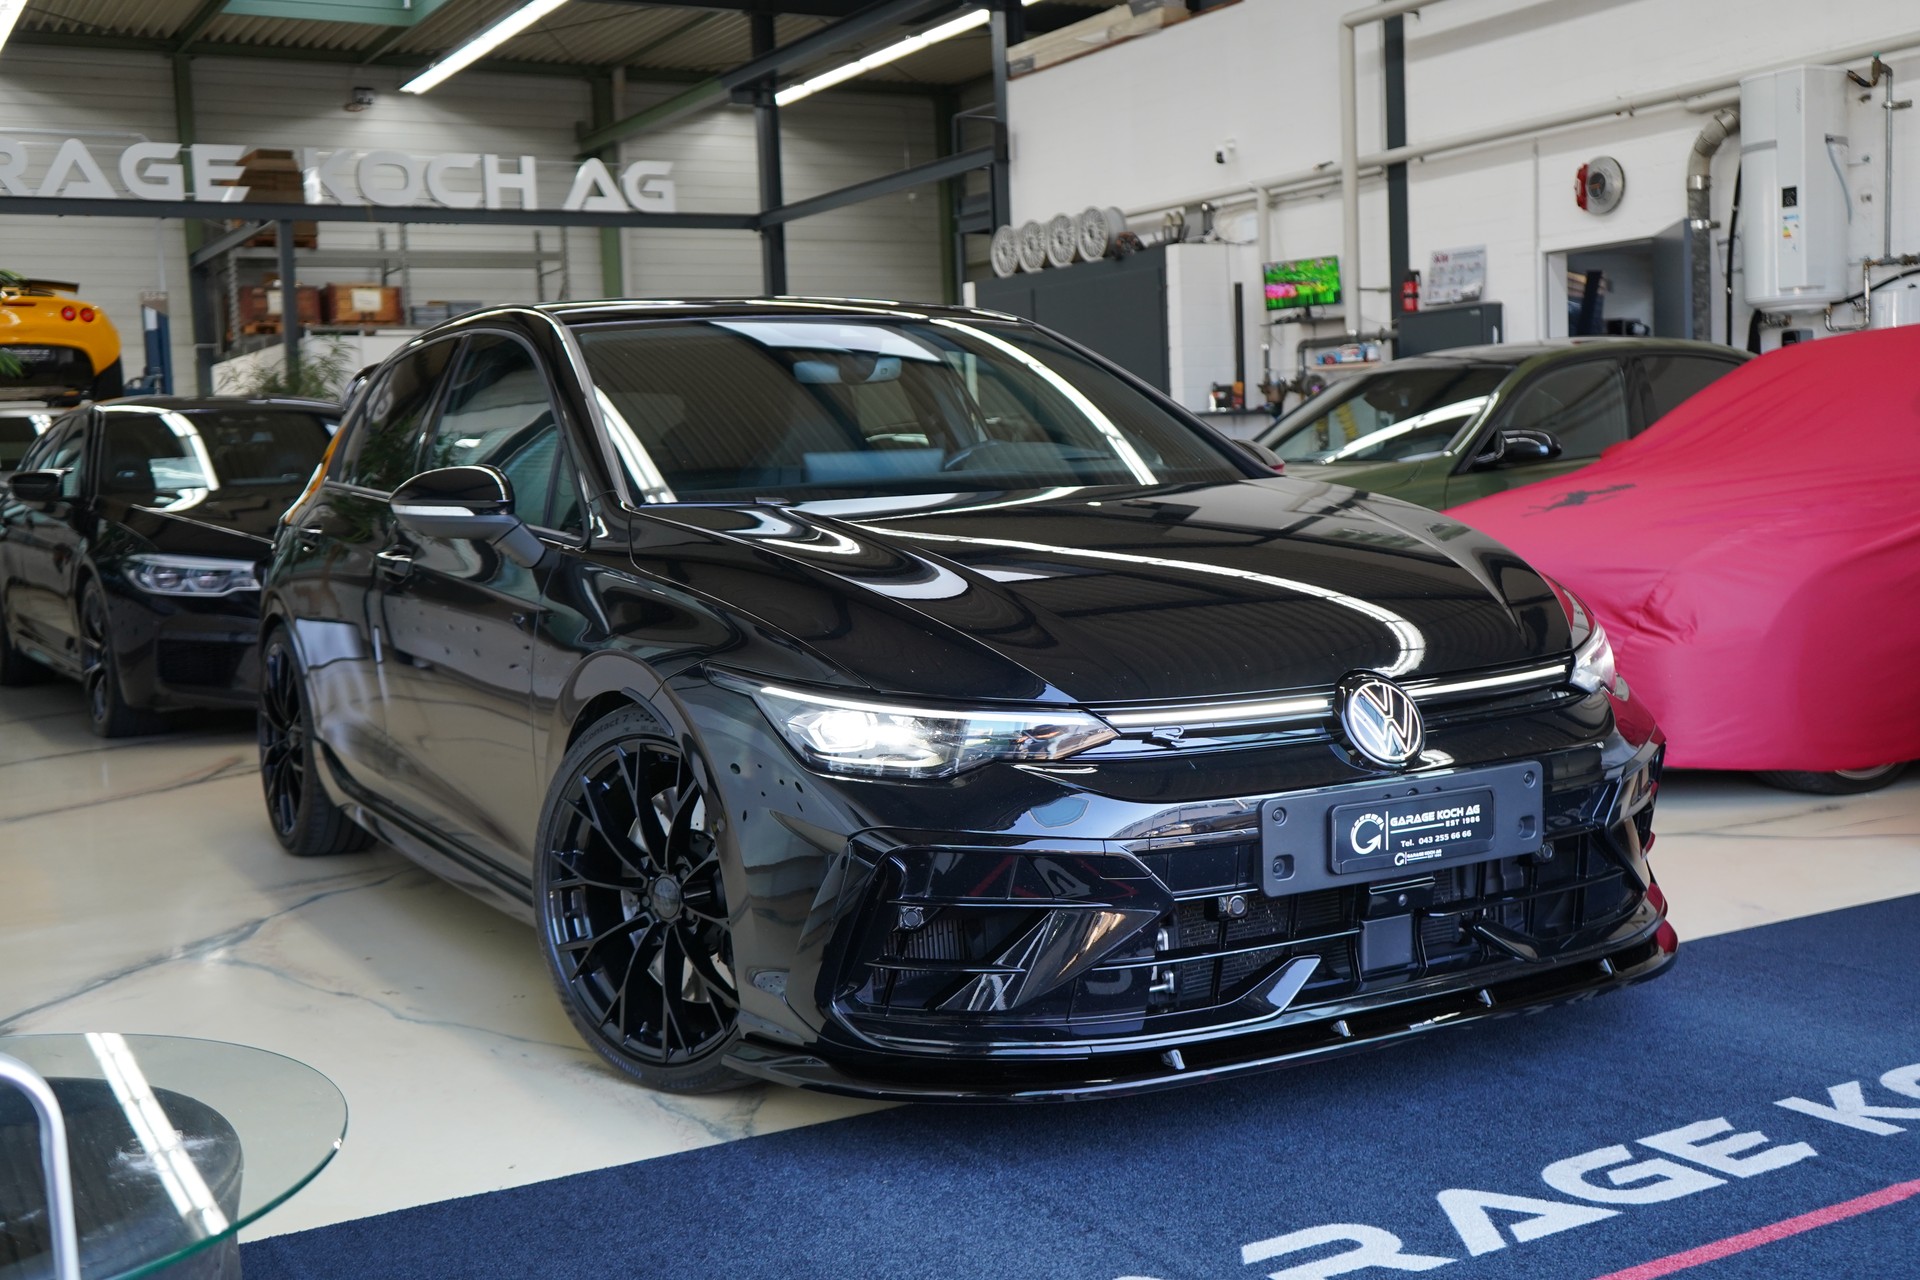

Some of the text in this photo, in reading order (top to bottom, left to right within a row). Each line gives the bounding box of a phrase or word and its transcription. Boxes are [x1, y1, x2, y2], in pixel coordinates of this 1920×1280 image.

[303, 148, 538, 210] KOCH
[562, 157, 677, 213] AG
[1390, 804, 1481, 827] GARAGE KOCH AG
[1445, 816, 1481, 827] EST 1986
[1400, 829, 1472, 848] Tel. 043 255 66 66
[1112, 1117, 1819, 1280] RAGE
